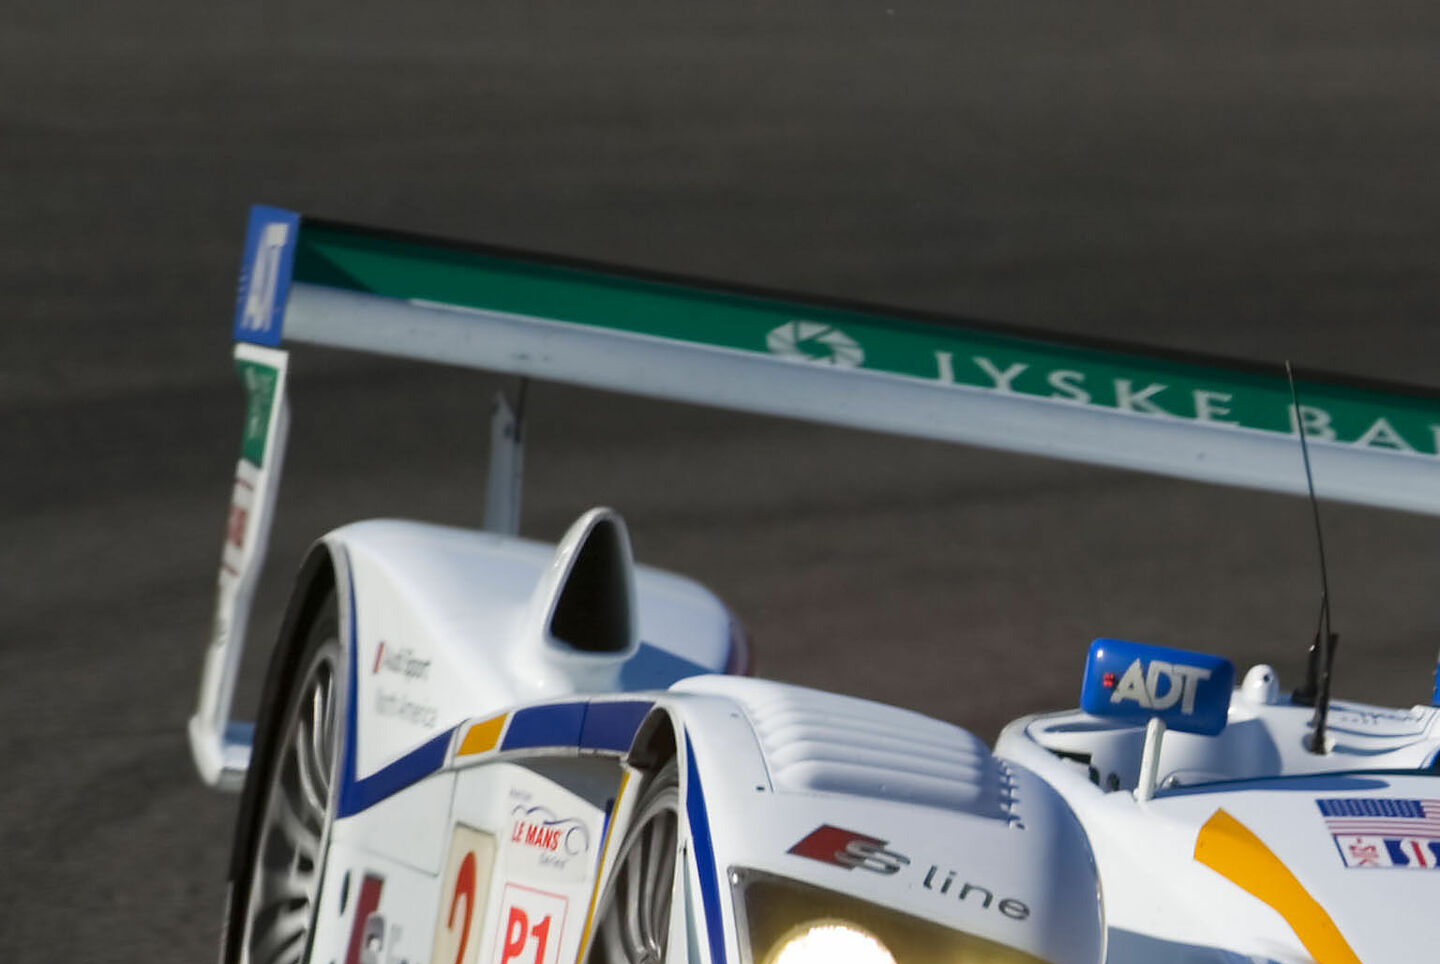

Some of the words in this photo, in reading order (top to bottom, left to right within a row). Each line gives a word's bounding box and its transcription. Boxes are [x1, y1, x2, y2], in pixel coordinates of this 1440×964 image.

[936, 351, 1240, 428] JYSKE
[1110, 658, 1212, 716] ADT
[510, 820, 525, 843] LE
[525, 824, 562, 852] MANS
[922, 864, 1031, 922] line
